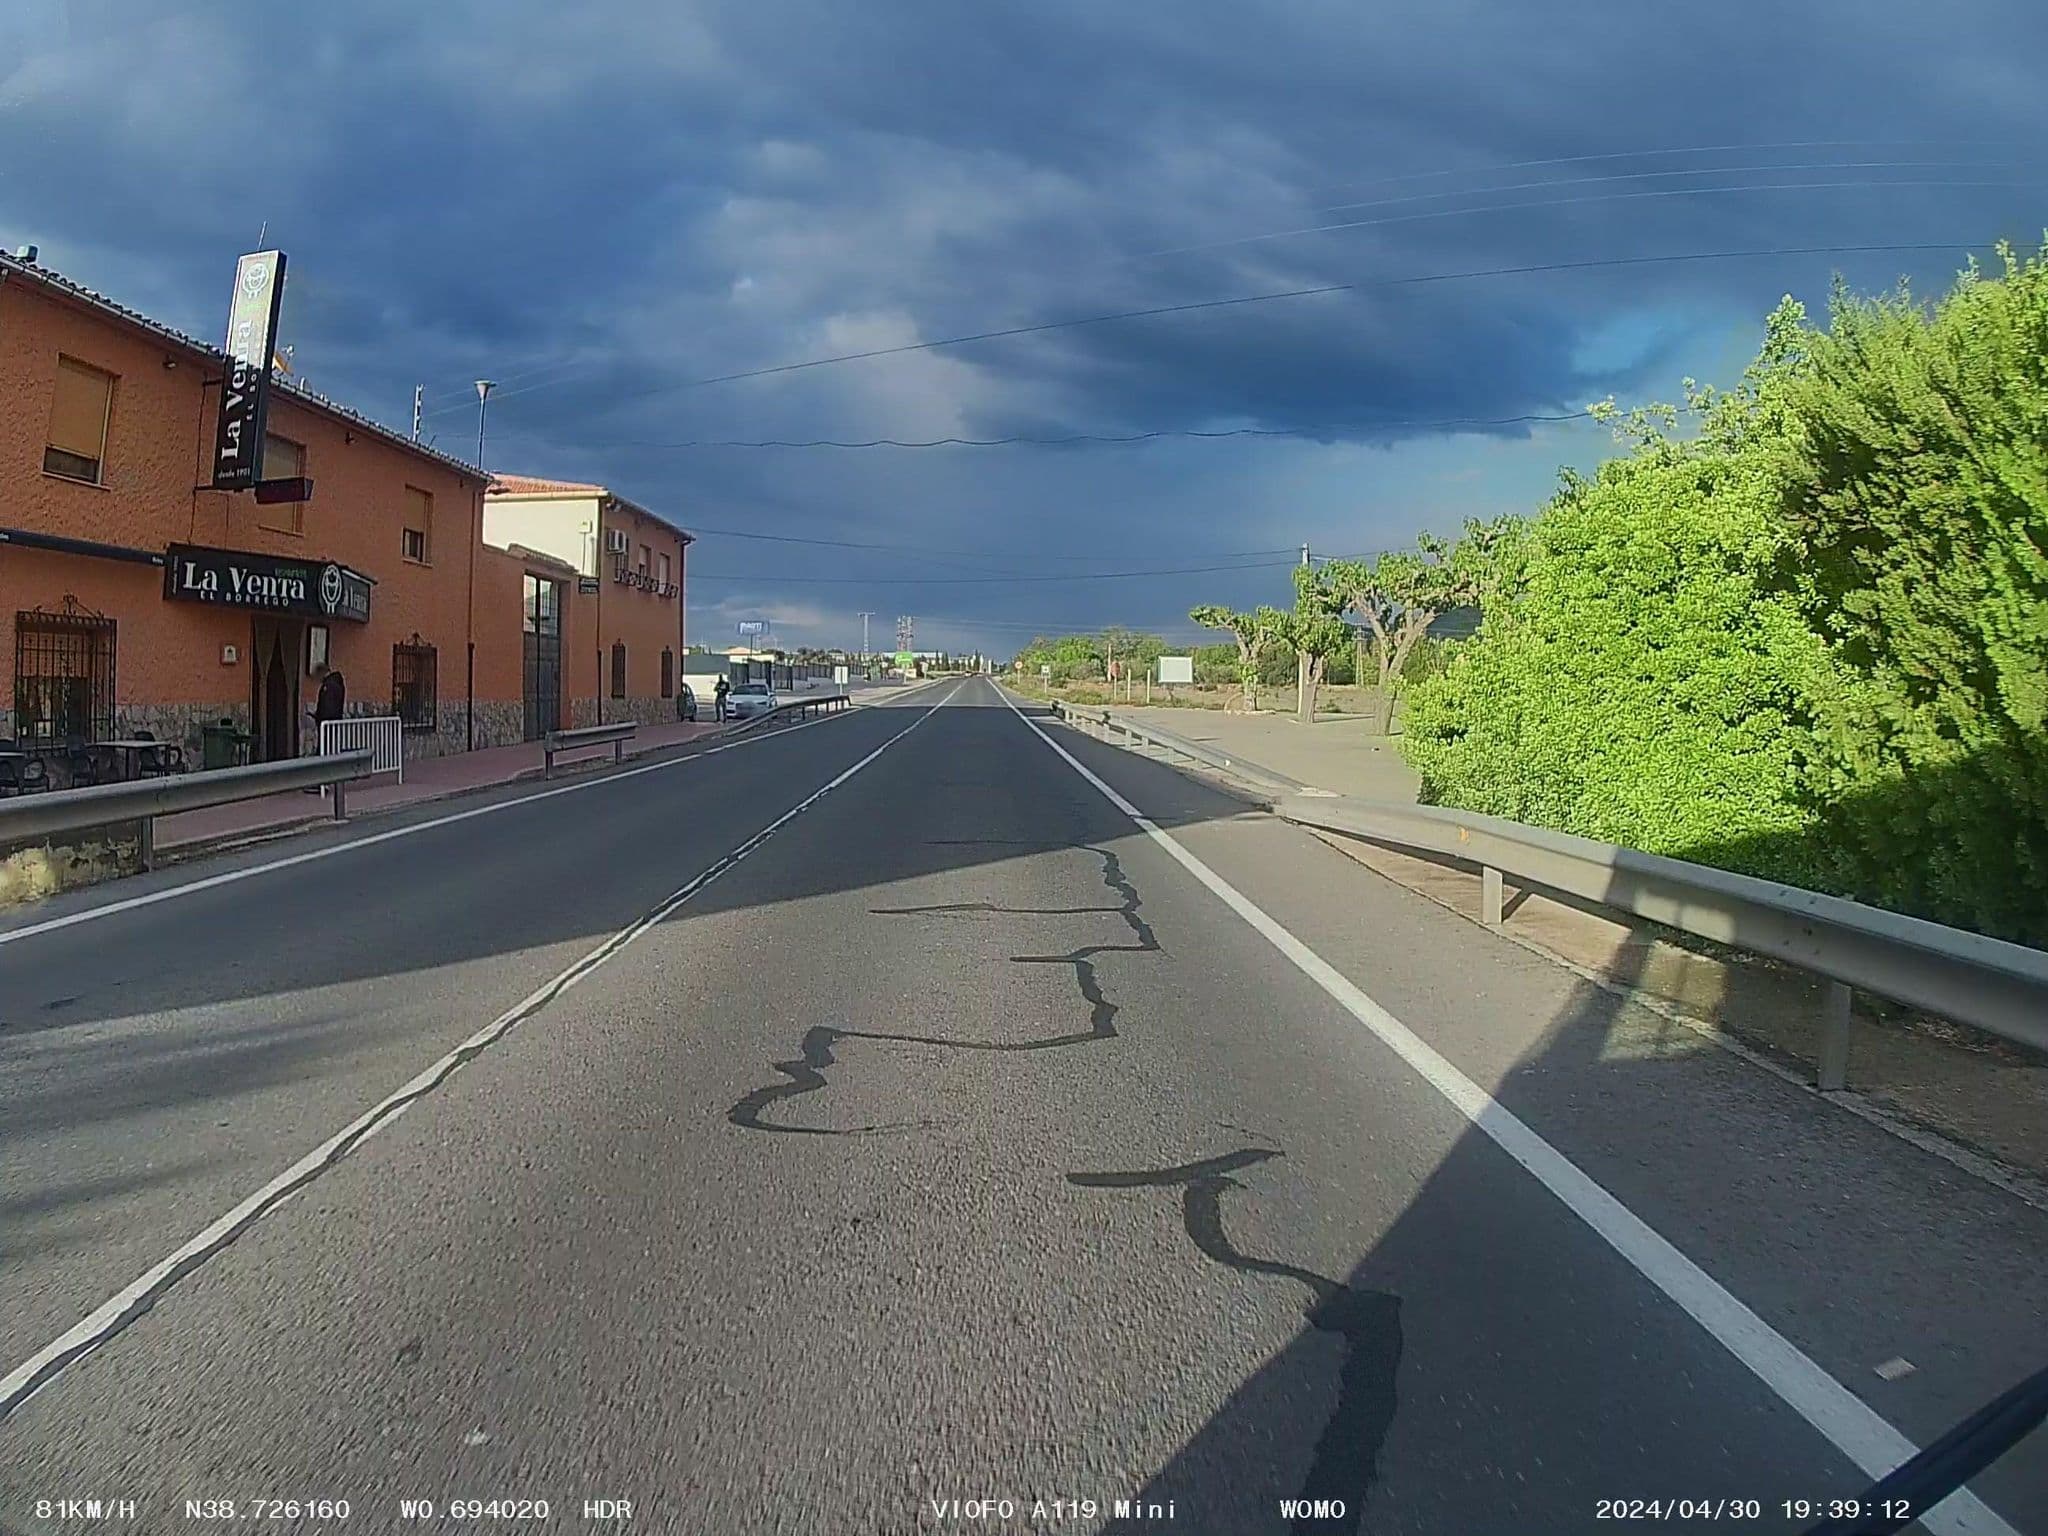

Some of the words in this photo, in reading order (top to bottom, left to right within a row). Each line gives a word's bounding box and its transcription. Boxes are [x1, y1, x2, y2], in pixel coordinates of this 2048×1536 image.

[221, 419, 241, 460] La
[183, 562, 218, 592] La
[200, 591, 215, 601] EL
[225, 590, 290, 607] BORREGO
